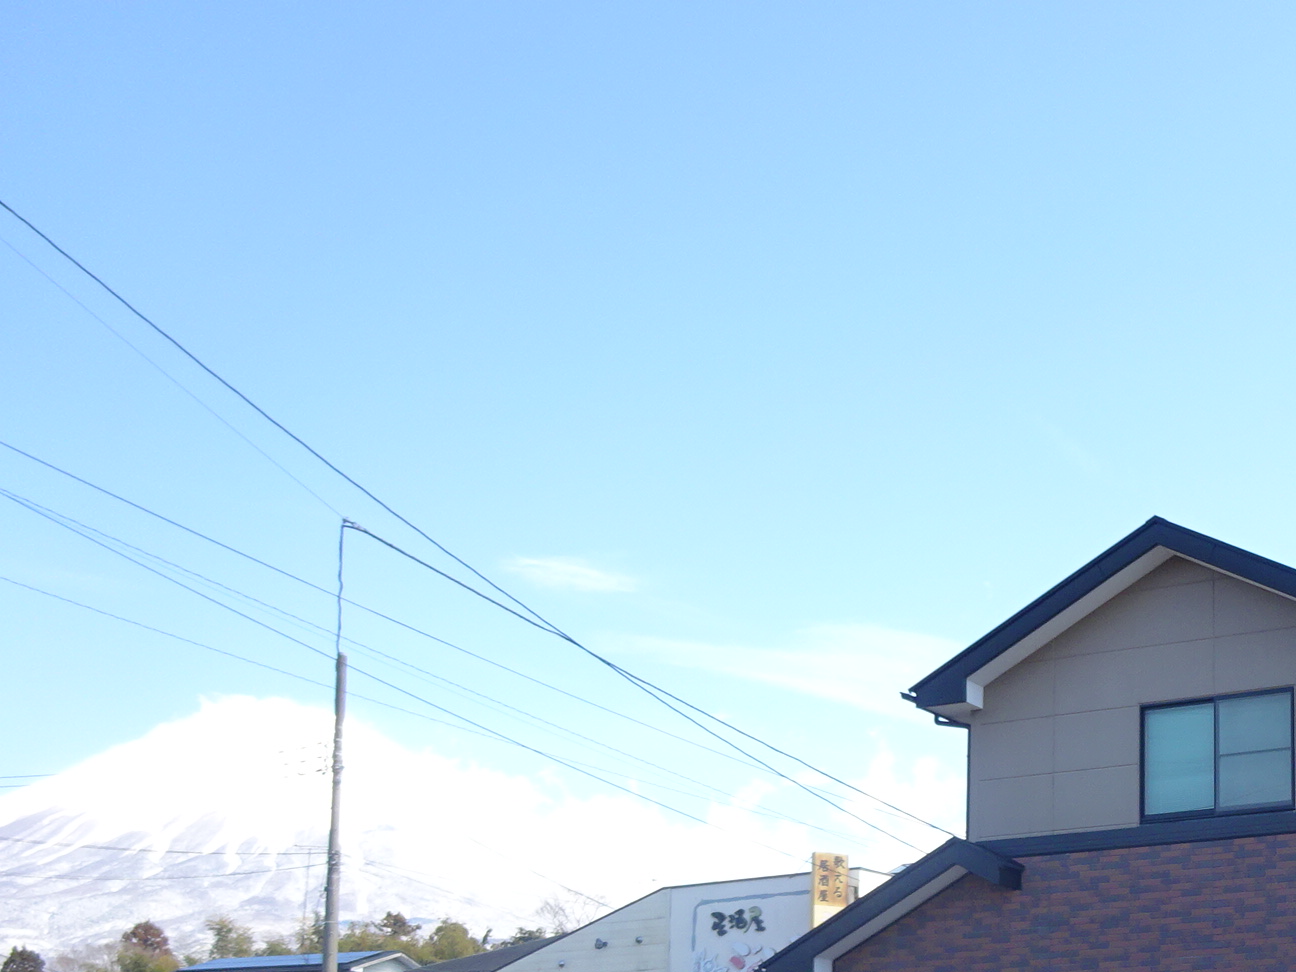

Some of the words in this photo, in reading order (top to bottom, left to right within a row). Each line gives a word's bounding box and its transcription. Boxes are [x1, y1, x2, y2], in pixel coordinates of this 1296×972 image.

[817, 859, 830, 902] 居酒屋
[833, 855, 846, 898] 歌える
